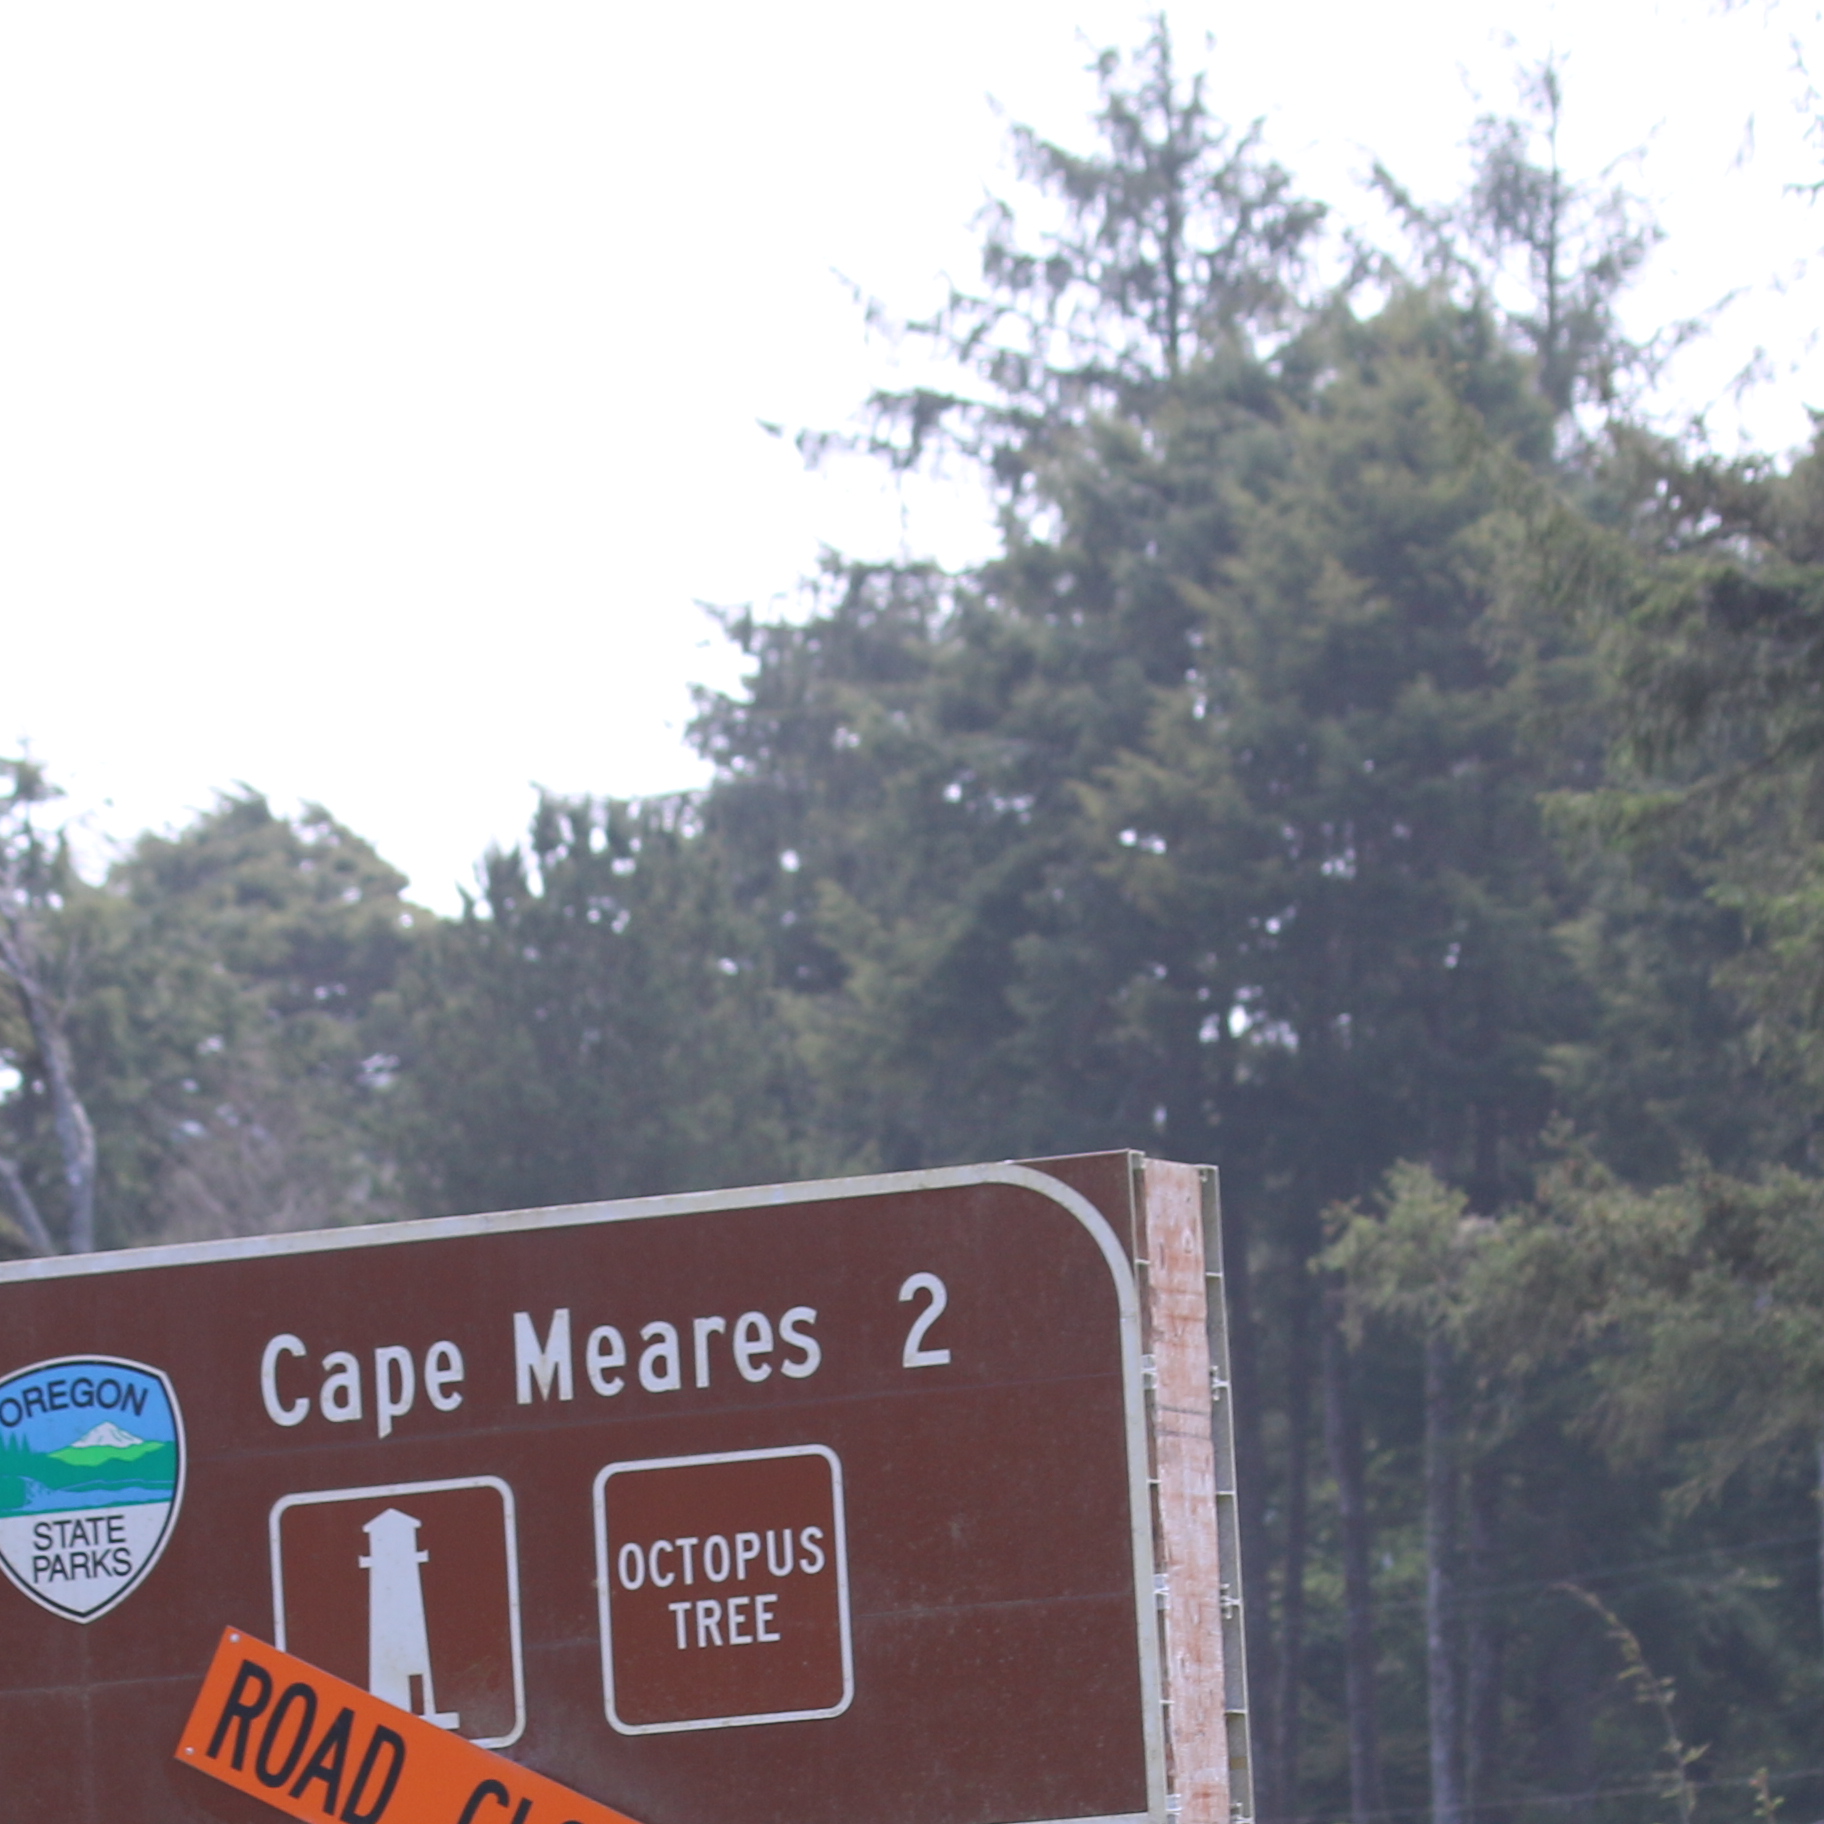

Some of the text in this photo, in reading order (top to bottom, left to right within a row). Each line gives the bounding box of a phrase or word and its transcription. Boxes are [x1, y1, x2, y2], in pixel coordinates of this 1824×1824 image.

[260, 1271, 952, 1440] Cape Meares 2
[32, 1514, 127, 1553] STATE
[617, 1525, 826, 1590] OCTOPUS
[32, 1547, 133, 1584] PARKS
[668, 1593, 782, 1650] TREE
